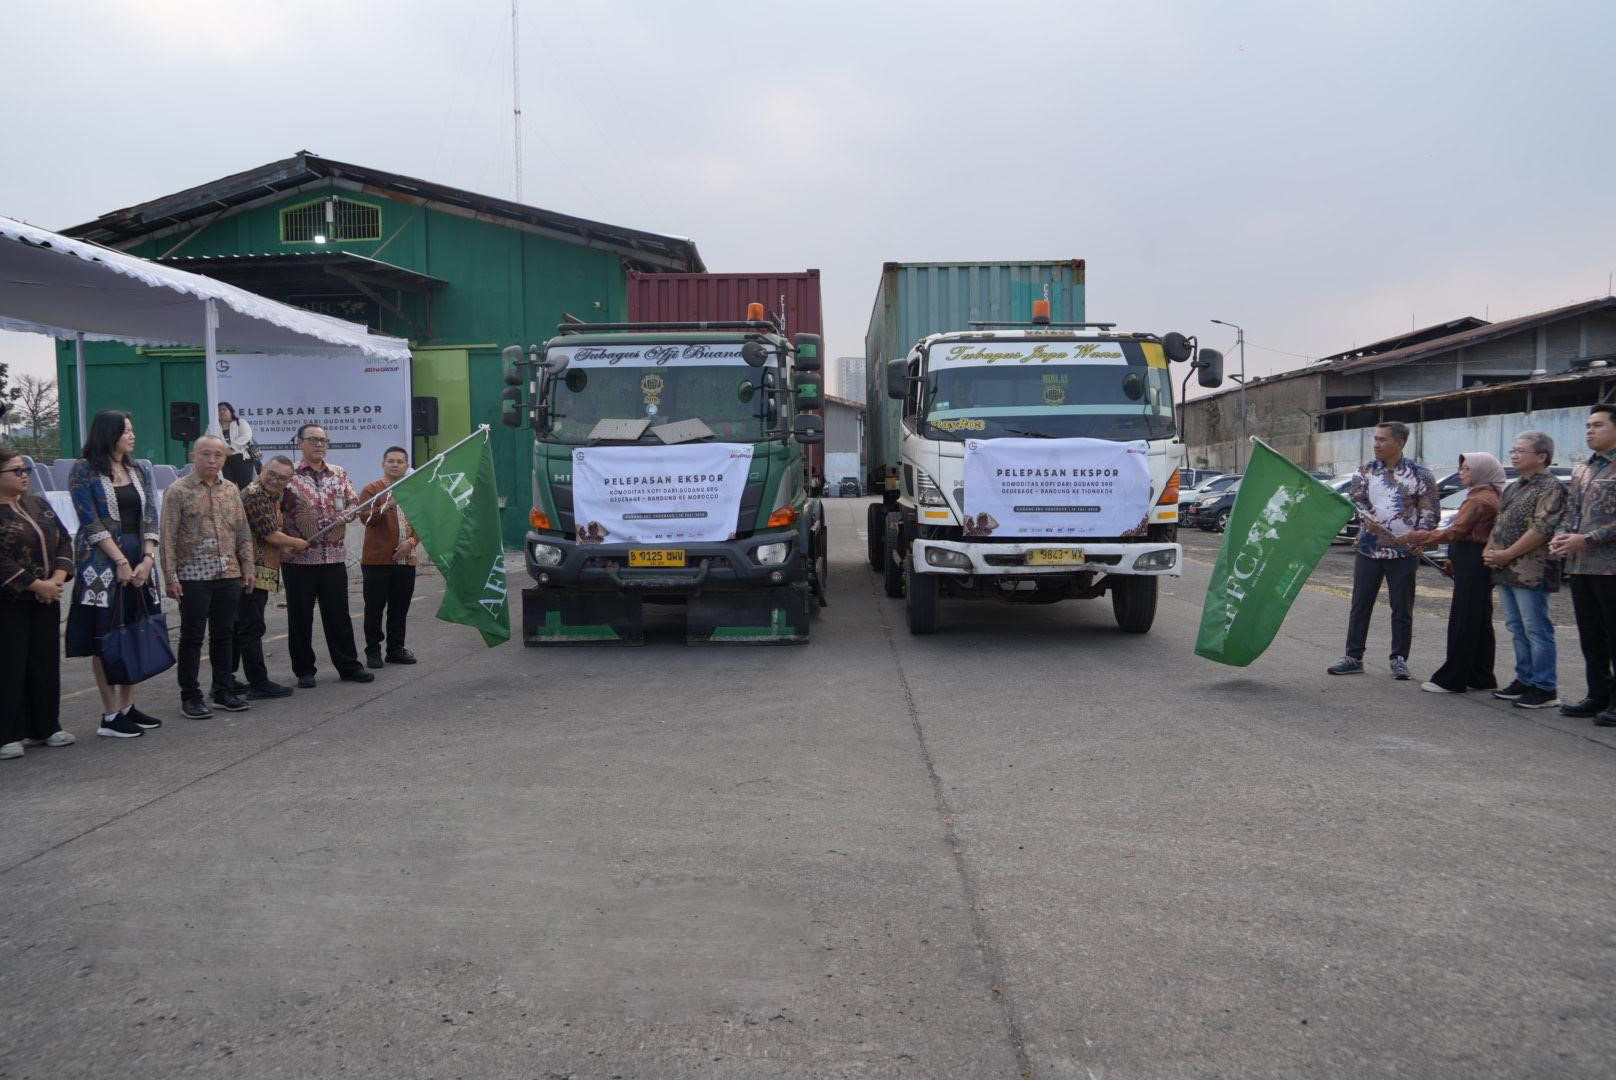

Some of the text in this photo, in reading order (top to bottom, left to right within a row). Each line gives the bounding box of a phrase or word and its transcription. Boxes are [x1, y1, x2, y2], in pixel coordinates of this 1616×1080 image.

[238, 405, 382, 416] ELEPASAN EKSPOR
[996, 469, 1119, 477] PELEPASAN EKSPOR
[604, 474, 724, 486] PELEPASAN EKSPOR
[609, 488, 645, 497] KOMODITAS
[630, 551, 637, 561] B
[1028, 551, 1034, 560] B
